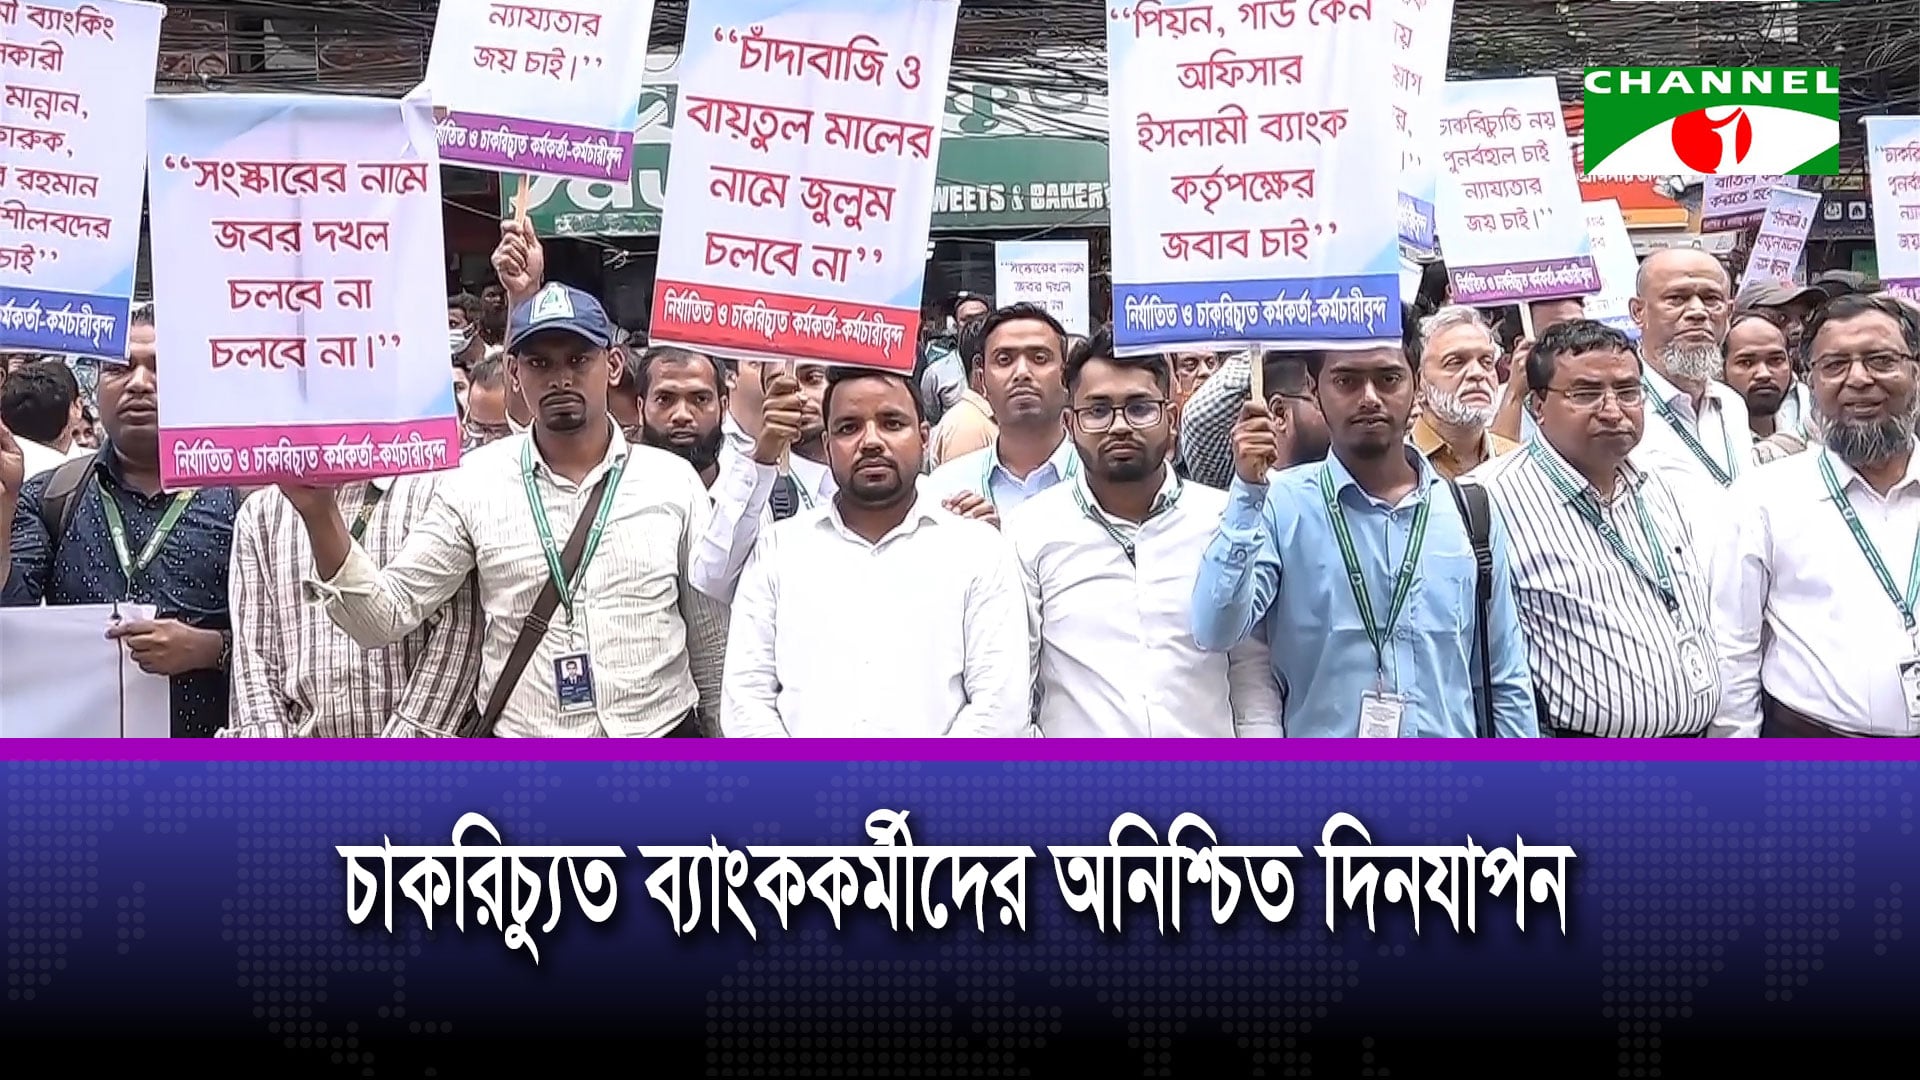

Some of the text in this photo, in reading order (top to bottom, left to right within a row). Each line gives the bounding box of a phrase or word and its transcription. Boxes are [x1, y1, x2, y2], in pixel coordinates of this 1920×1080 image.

[26, 5, 114, 41] ব্যাংকিং
[489, 3, 602, 37] ন্যায্যতার
[1308, 0, 1372, 26] কেন
[473, 46, 518, 74] জয়
[714, 26, 920, 89] “চাঁদাবাজি ও
[1176, 48, 1303, 90] অফিসার
[5, 85, 88, 121] মান্নান,
[1527, 111, 1556, 131] নয়
[469, 131, 478, 149] ও
[480, 124, 528, 161] চাকরিচ্যুত
[686, 96, 814, 152] বায়তুল
[825, 112, 934, 158] মালের
[1137, 104, 1248, 151] ইসলামী
[1258, 108, 1349, 144] ব্যাংক
[1522, 139, 1550, 162] চাই
[15, 168, 98, 198] রহমান
[165, 156, 428, 197] “সংস্কারের নামে
[1171, 164, 1315, 215] কর্তৃপক্ষের
[710, 165, 790, 208] নামে
[800, 177, 896, 230] জুলুম
[1011, 185, 1024, 210] &
[212, 221, 389, 252] জবর দখল
[1464, 213, 1496, 233] জয়
[705, 232, 802, 276] চলবে
[1160, 230, 1250, 261] জবাব
[228, 279, 372, 311] চলবে না
[1125, 287, 1388, 334] নির্যাতিত ও চাকরিচ্যুত কর্মকর্তা-কর্মচারীবৃন্দ
[0, 297, 116, 348] র্মকর্তা-কর্মচারীবৃন্দ
[664, 288, 905, 358] নির্যাতিত ও চাকরিচ্যুত কর্মকর্তা-কর্মচারীবৃন্দ
[209, 338, 306, 369] চলবে
[173, 431, 447, 479] নির্যাতিত ও চাকরিচ্যুত কর্মকর্তা-কর্মচারীবৃন্দ
